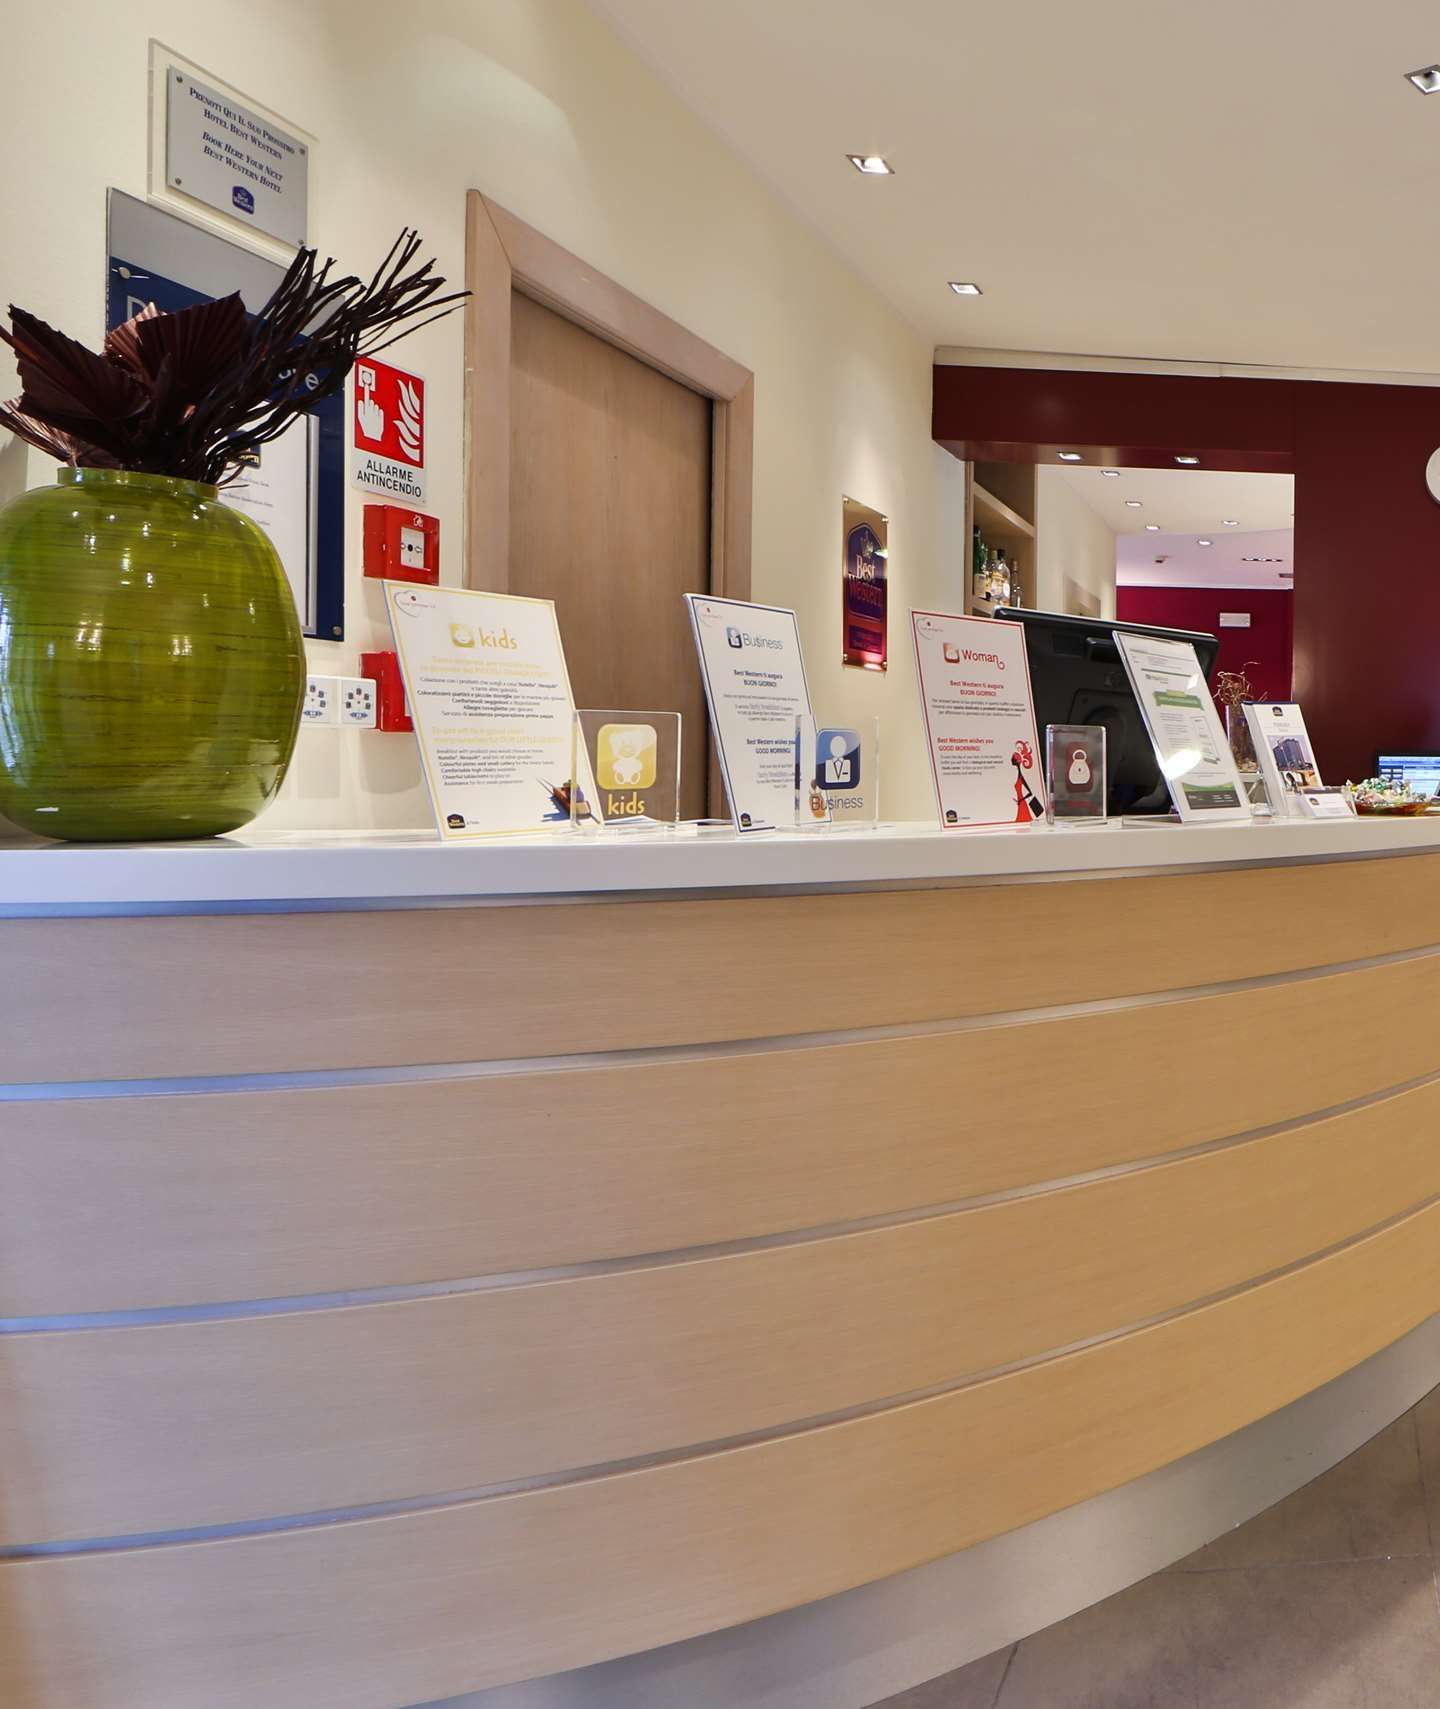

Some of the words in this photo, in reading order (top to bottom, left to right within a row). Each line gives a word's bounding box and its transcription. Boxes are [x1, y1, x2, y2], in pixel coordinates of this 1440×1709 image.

[366, 459, 413, 483] ALLARME
[356, 470, 422, 498] ANTINCENDIO
[856, 554, 876, 581] Best
[478, 626, 518, 650] kids
[742, 632, 783, 650] Business
[961, 649, 1006, 670] Woman
[607, 791, 646, 816] kids
[810, 796, 864, 811] Business
